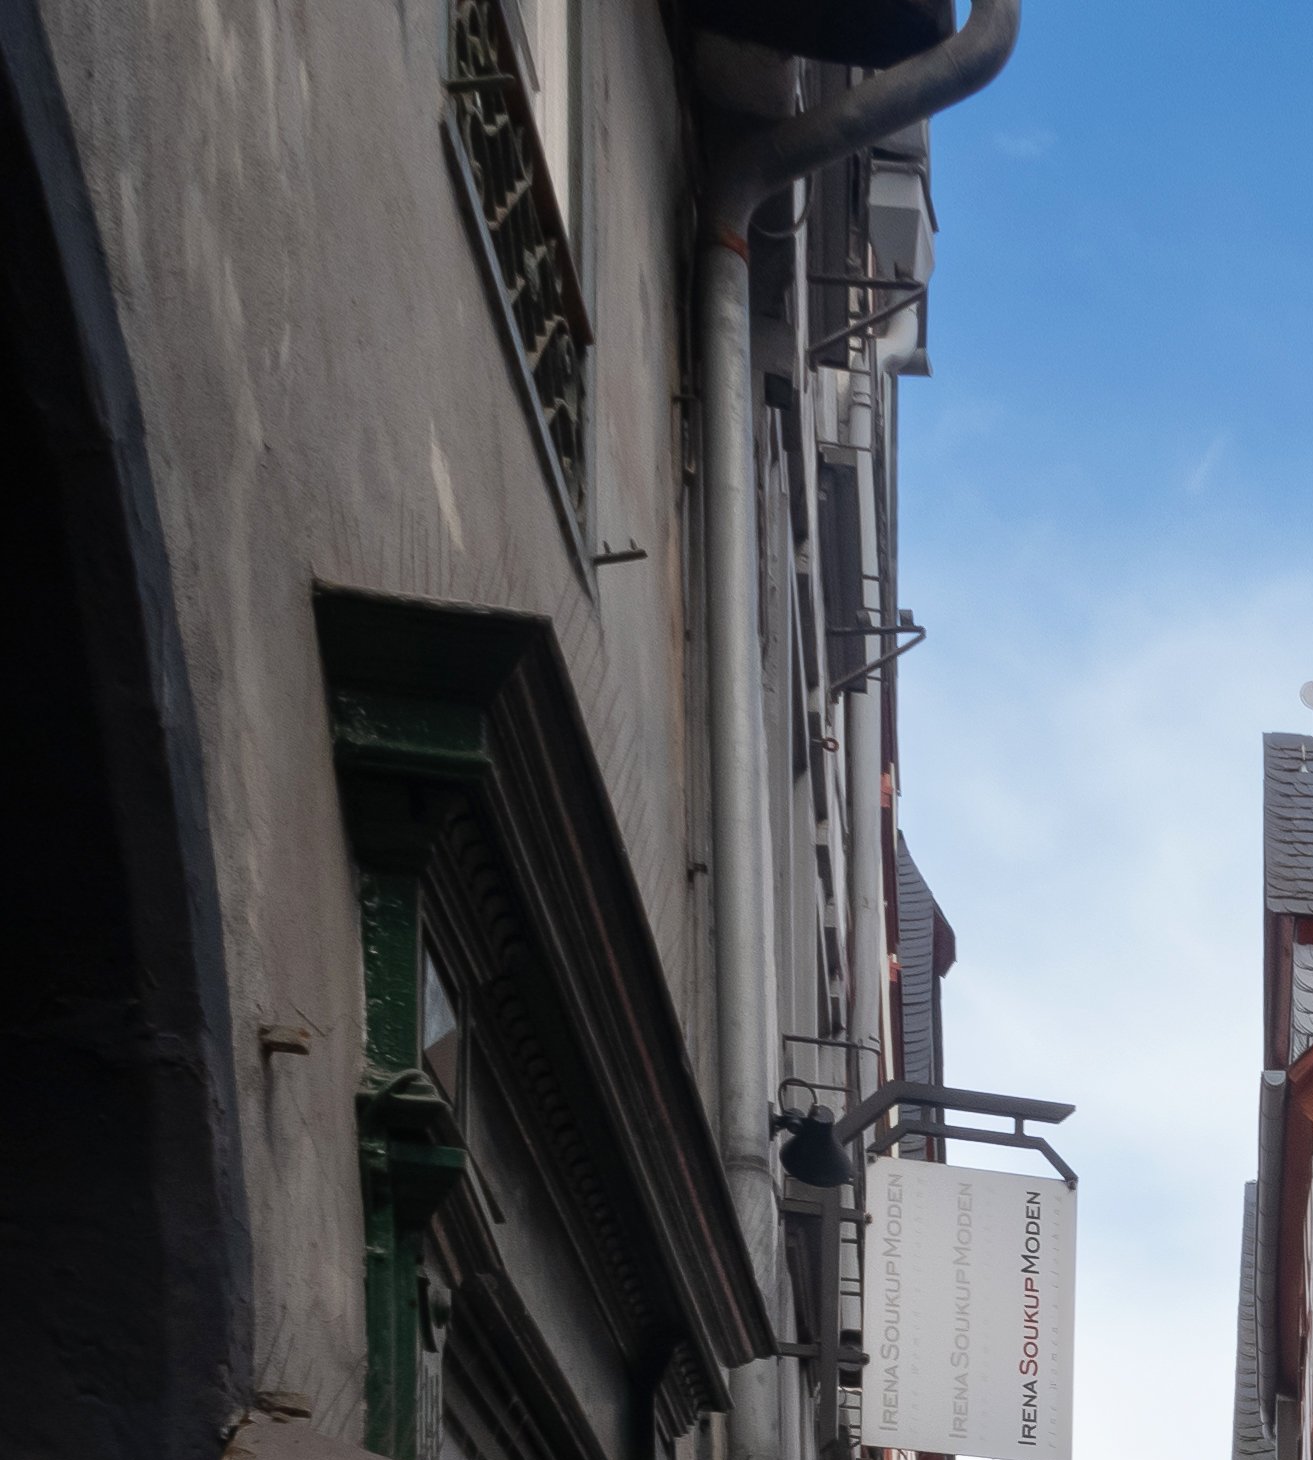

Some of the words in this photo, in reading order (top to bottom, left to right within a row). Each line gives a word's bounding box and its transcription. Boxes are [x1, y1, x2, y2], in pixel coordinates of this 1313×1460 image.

[882, 1173, 903, 1259] MODEN
[953, 1182, 973, 1267] MODEN
[1021, 1191, 1041, 1275] MODEN
[880, 1261, 901, 1361] SOUKUP
[950, 1269, 972, 1369] SOUKUP
[1019, 1277, 1039, 1377] SOUKUP
[879, 1365, 899, 1431] IRENA
[949, 1373, 969, 1439] IRENA
[1018, 1380, 1038, 1446] IRENA
